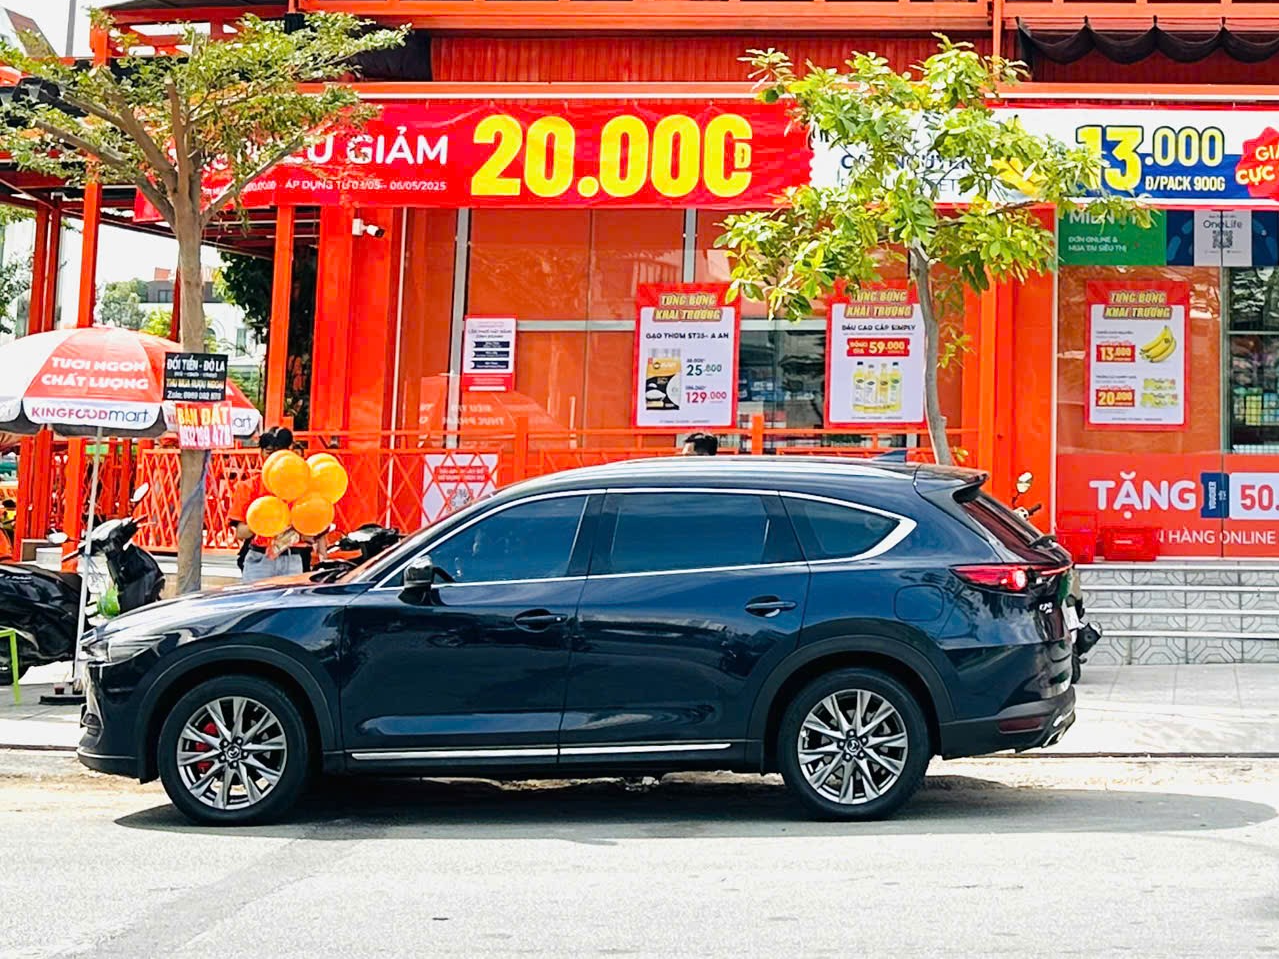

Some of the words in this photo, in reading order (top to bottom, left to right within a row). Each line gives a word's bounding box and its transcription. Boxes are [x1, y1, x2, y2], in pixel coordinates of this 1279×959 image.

[346, 127, 448, 165] GIẢM
[1194, 175, 1226, 191] 900G
[1235, 169, 1276, 187] CỰC
[93, 360, 148, 373] NGON
[41, 372, 88, 388] CHẤT
[1089, 471, 1197, 520] TẶNG
[1169, 526, 1215, 544] HÀNG
[1219, 529, 1276, 544] ONLINE
